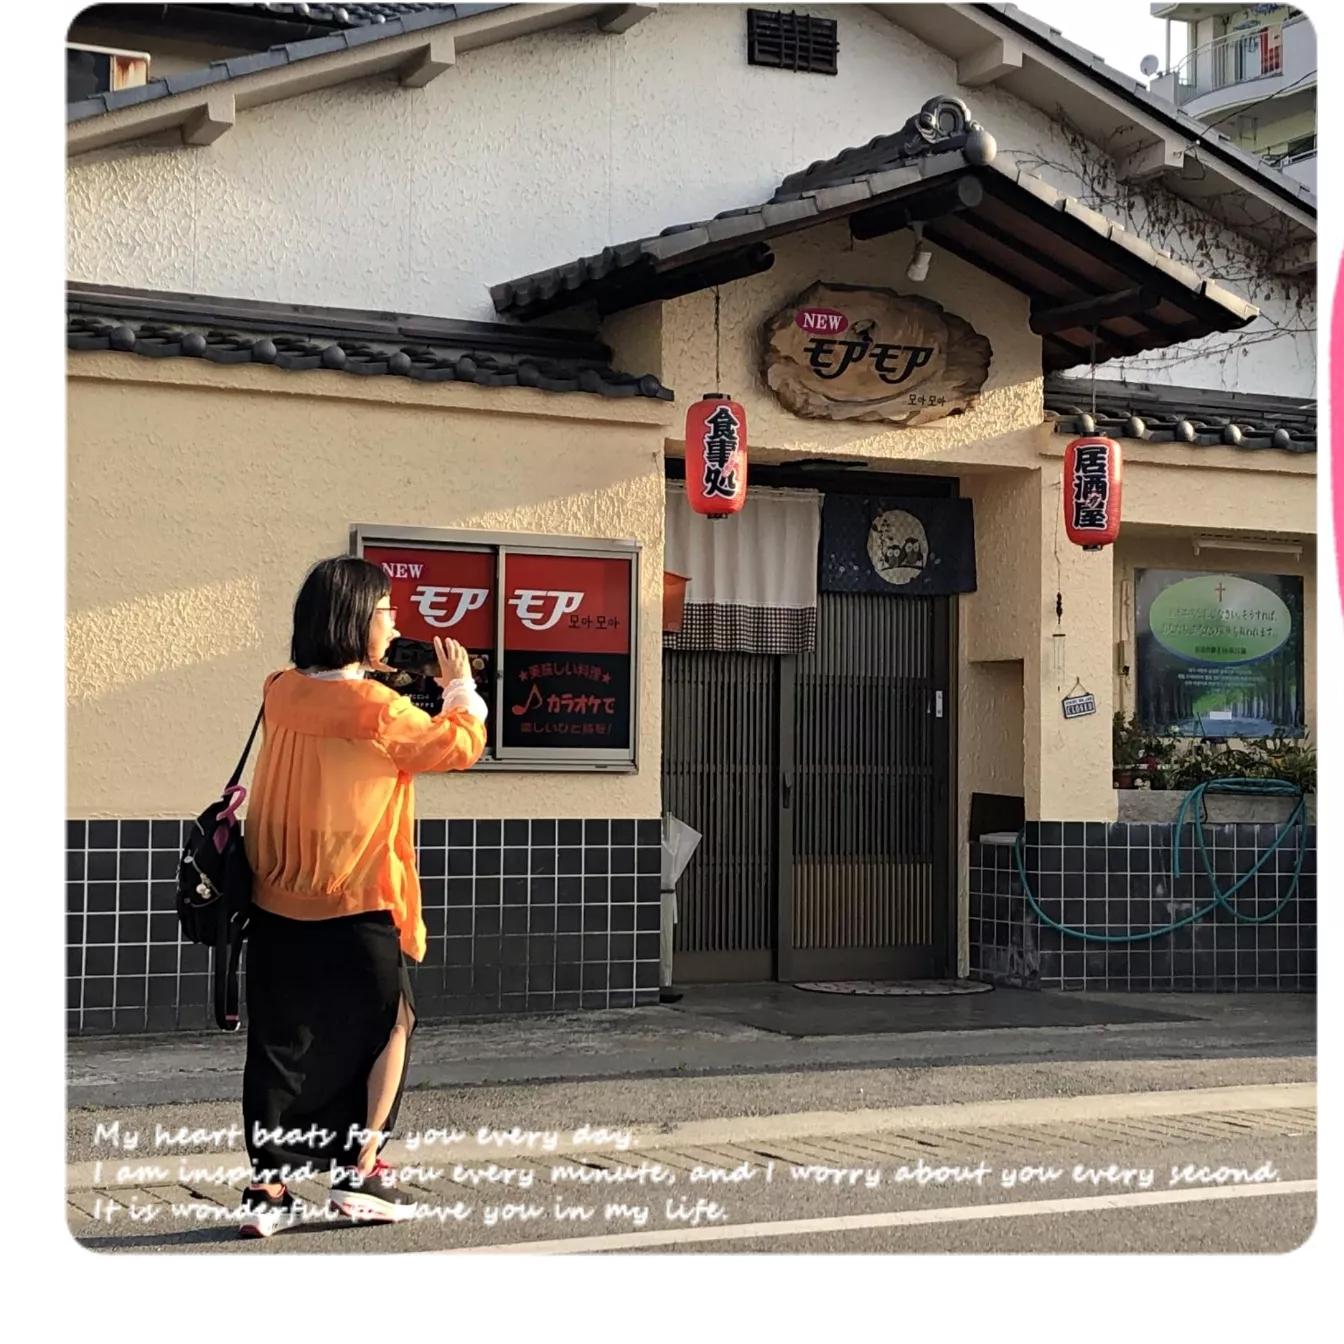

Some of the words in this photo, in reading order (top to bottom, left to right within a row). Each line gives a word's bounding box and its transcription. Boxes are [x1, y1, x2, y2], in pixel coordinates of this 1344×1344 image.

[803, 312, 843, 331] NEW
[703, 405, 740, 499] 食事処
[1072, 444, 1109, 530] 居酒屋
[381, 562, 424, 579] NEW
[409, 585, 489, 628] モア
[508, 588, 585, 631] モア
